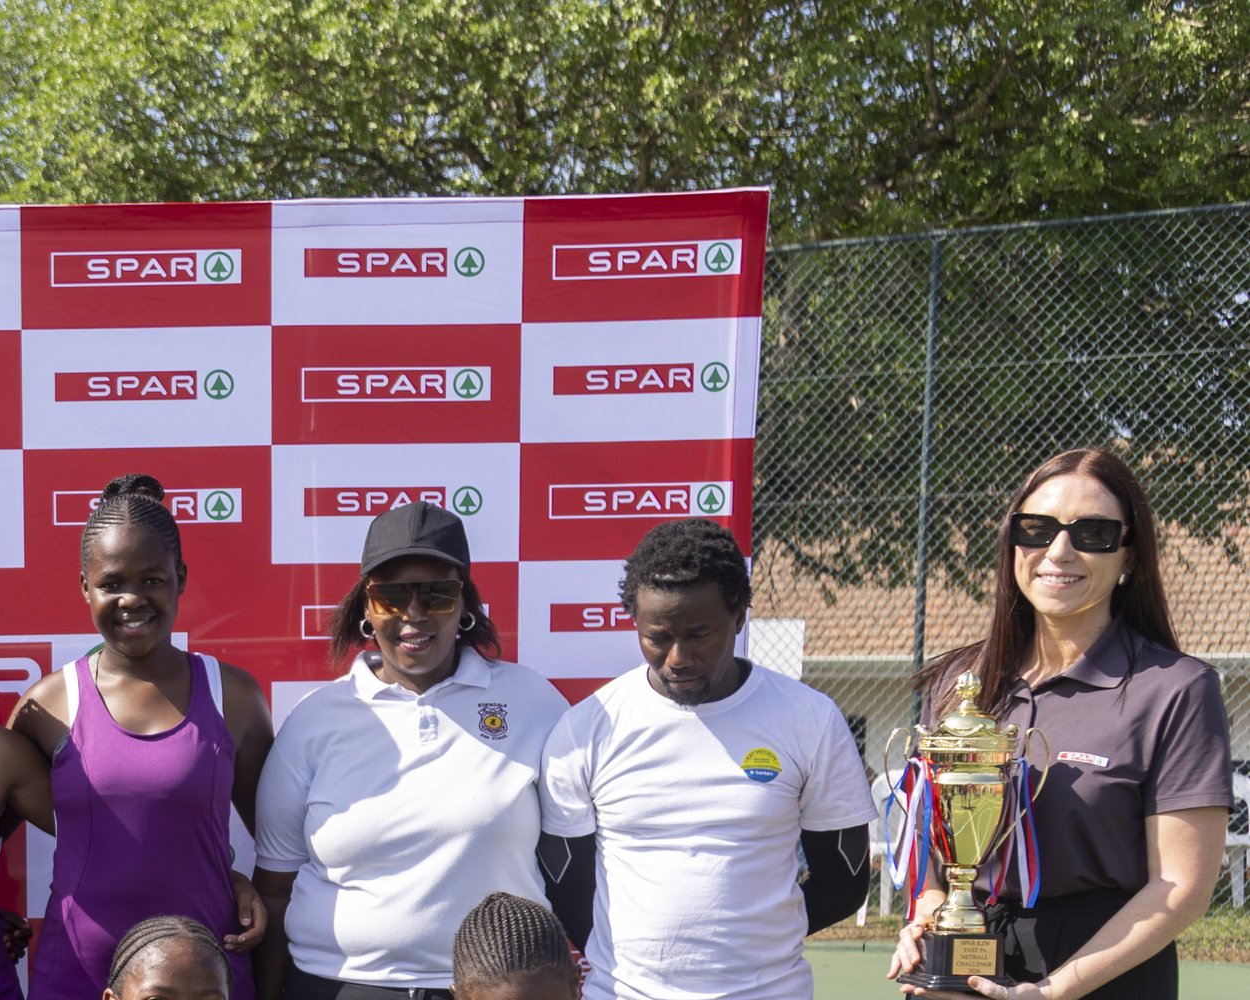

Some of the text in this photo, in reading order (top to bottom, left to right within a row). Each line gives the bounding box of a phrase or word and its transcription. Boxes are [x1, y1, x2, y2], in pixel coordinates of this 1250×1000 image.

[87, 257, 194, 279] SPAR
[337, 252, 445, 273] SPAR
[588, 248, 696, 272] SPAR
[87, 375, 195, 397] SPAR
[337, 373, 444, 394] SPAR
[586, 367, 691, 390] SPAR
[337, 491, 444, 512] SPAR
[584, 489, 688, 511] SPAR
[582, 607, 631, 628] SP
